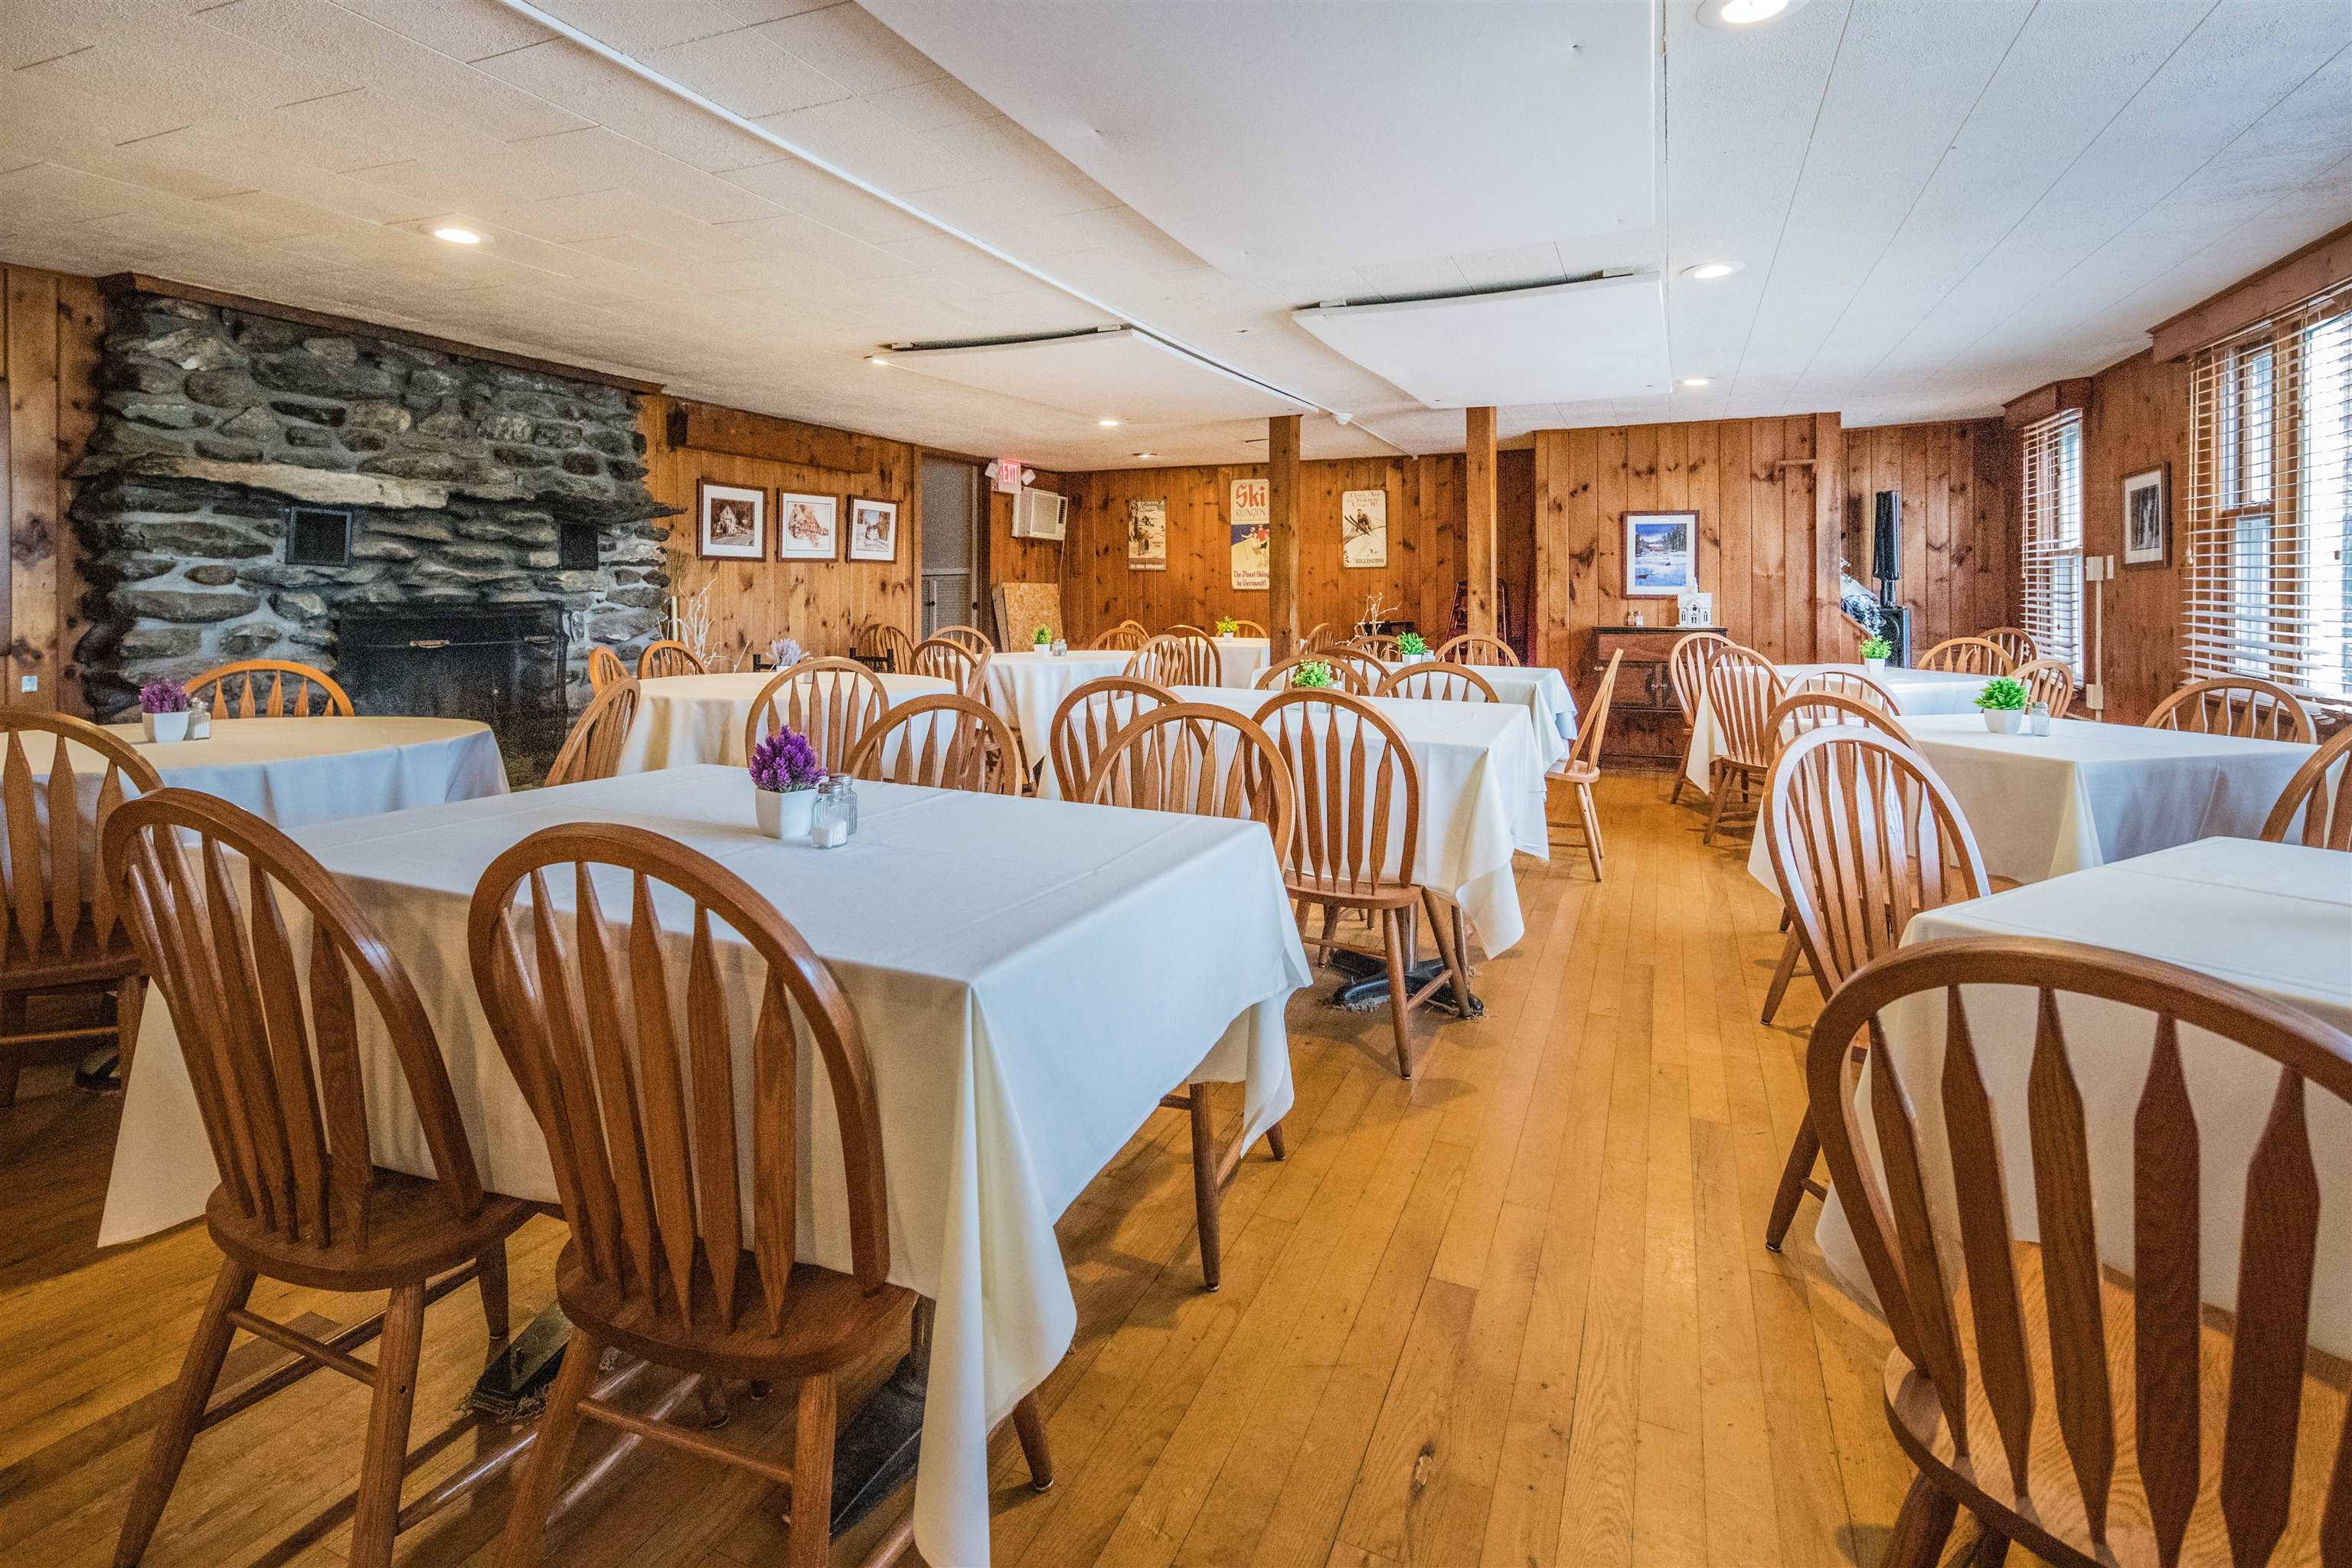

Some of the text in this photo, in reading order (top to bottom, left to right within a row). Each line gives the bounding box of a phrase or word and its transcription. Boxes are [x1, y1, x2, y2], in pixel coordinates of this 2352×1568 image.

[1003, 462, 1017, 484] EXIT
[1236, 483, 1266, 508] Ski
[1236, 508, 1266, 517] KILLINGTON
